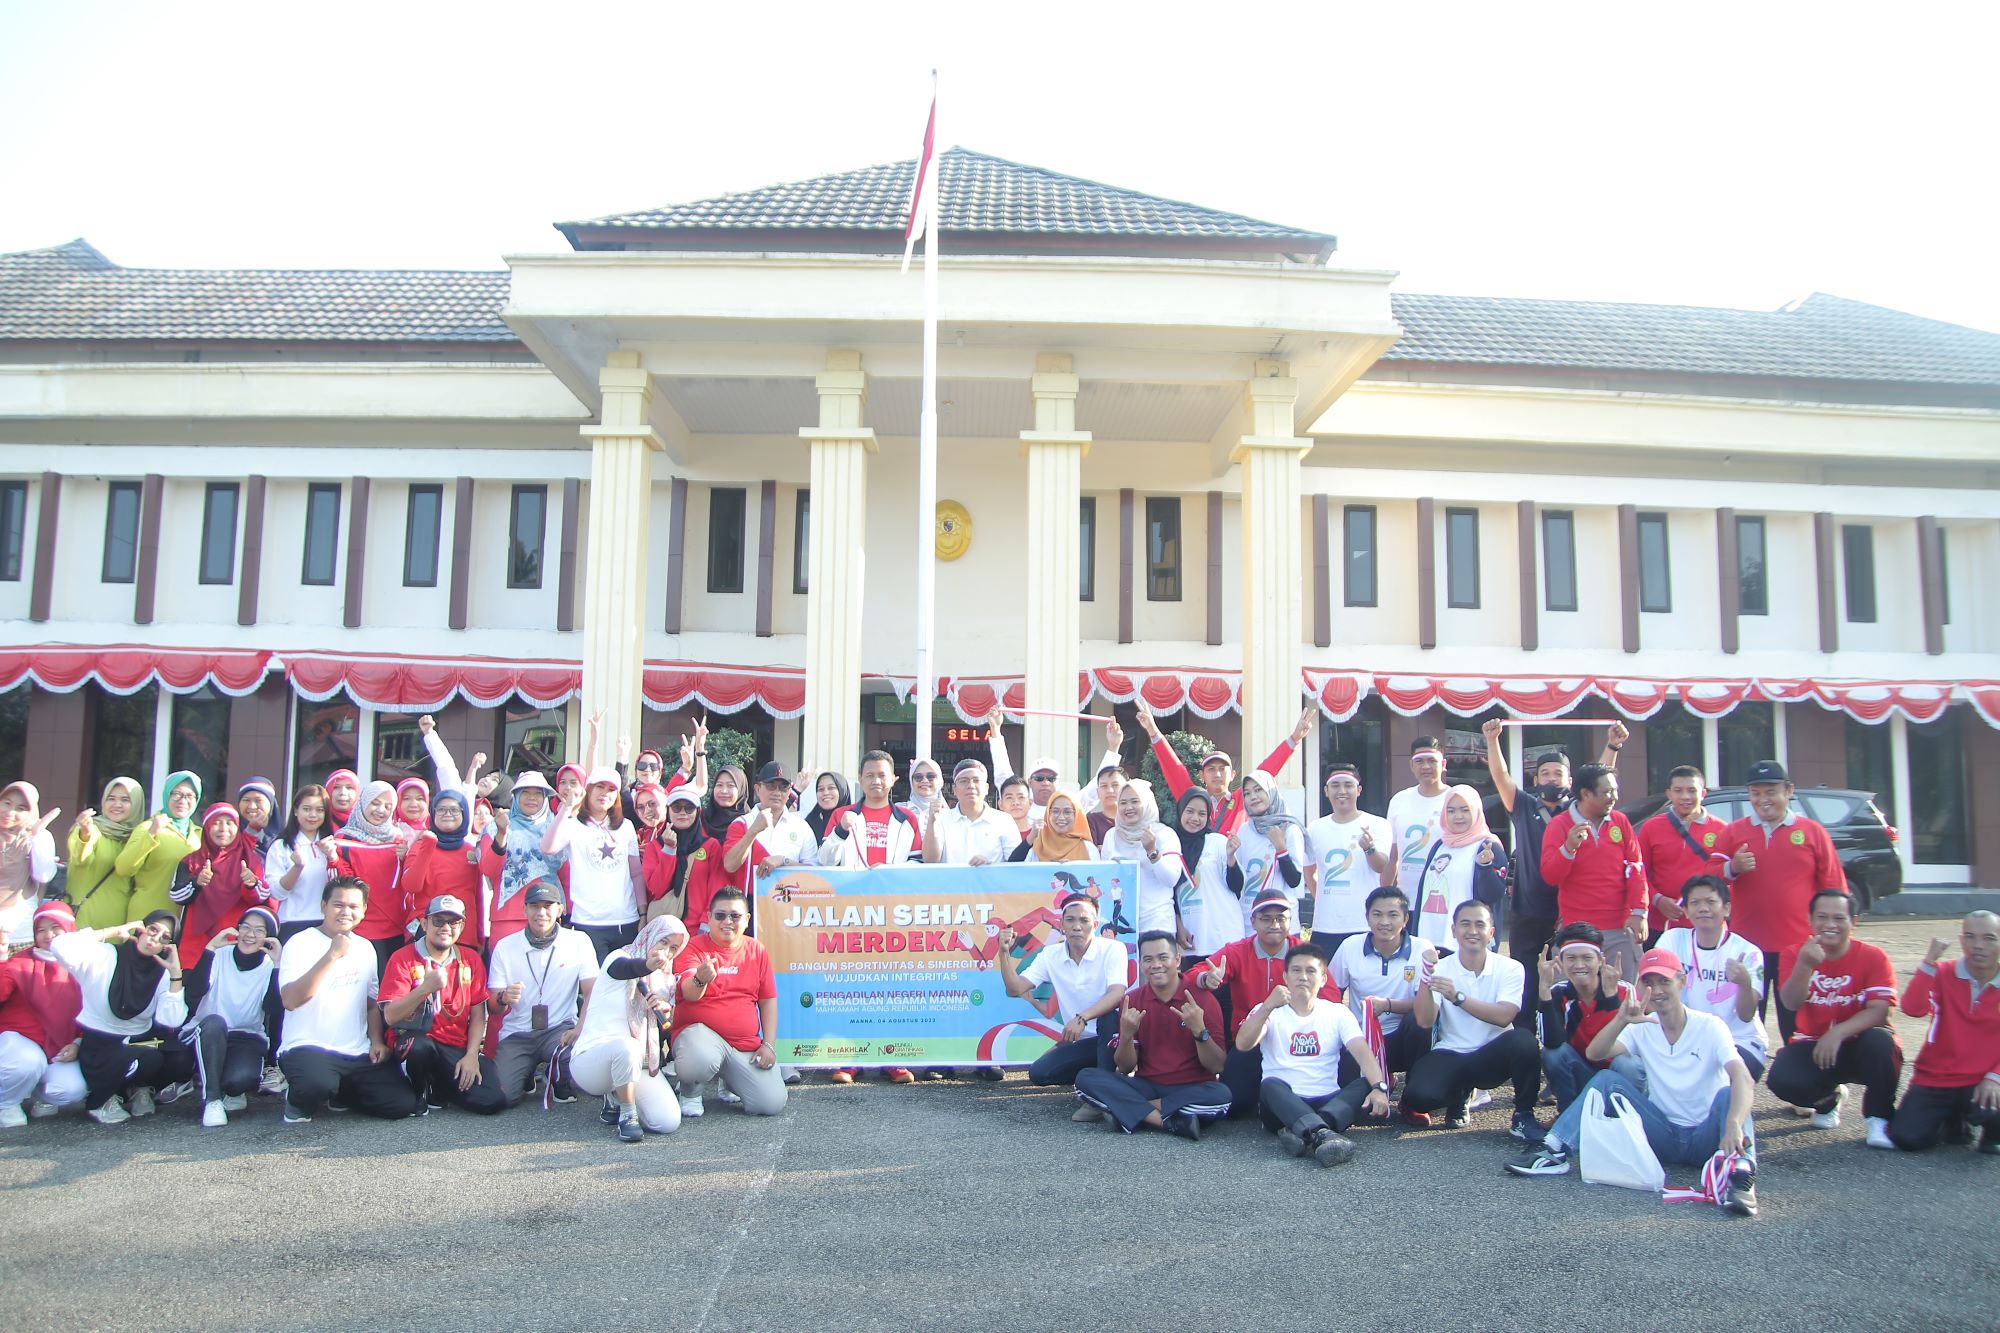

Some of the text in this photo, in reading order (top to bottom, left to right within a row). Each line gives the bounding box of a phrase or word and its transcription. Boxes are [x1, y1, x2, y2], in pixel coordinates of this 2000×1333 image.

[1402, 824, 1430, 864] 2
[1324, 848, 1353, 887] 2
[783, 903, 995, 927] JALAN SEHAT
[817, 930, 972, 953] MERDEKA
[790, 960, 994, 971] BANGUN SPORTIVITAS & SINERGITAS
[824, 972, 958, 982] WUJUDKAN INTEGRITAS
[1701, 968, 1729, 982] ONE
[815, 996, 970, 1006] PENGADILAN AGAMA MANNA
[816, 990, 969, 999] PENGADILAN NEGERI MANNA
